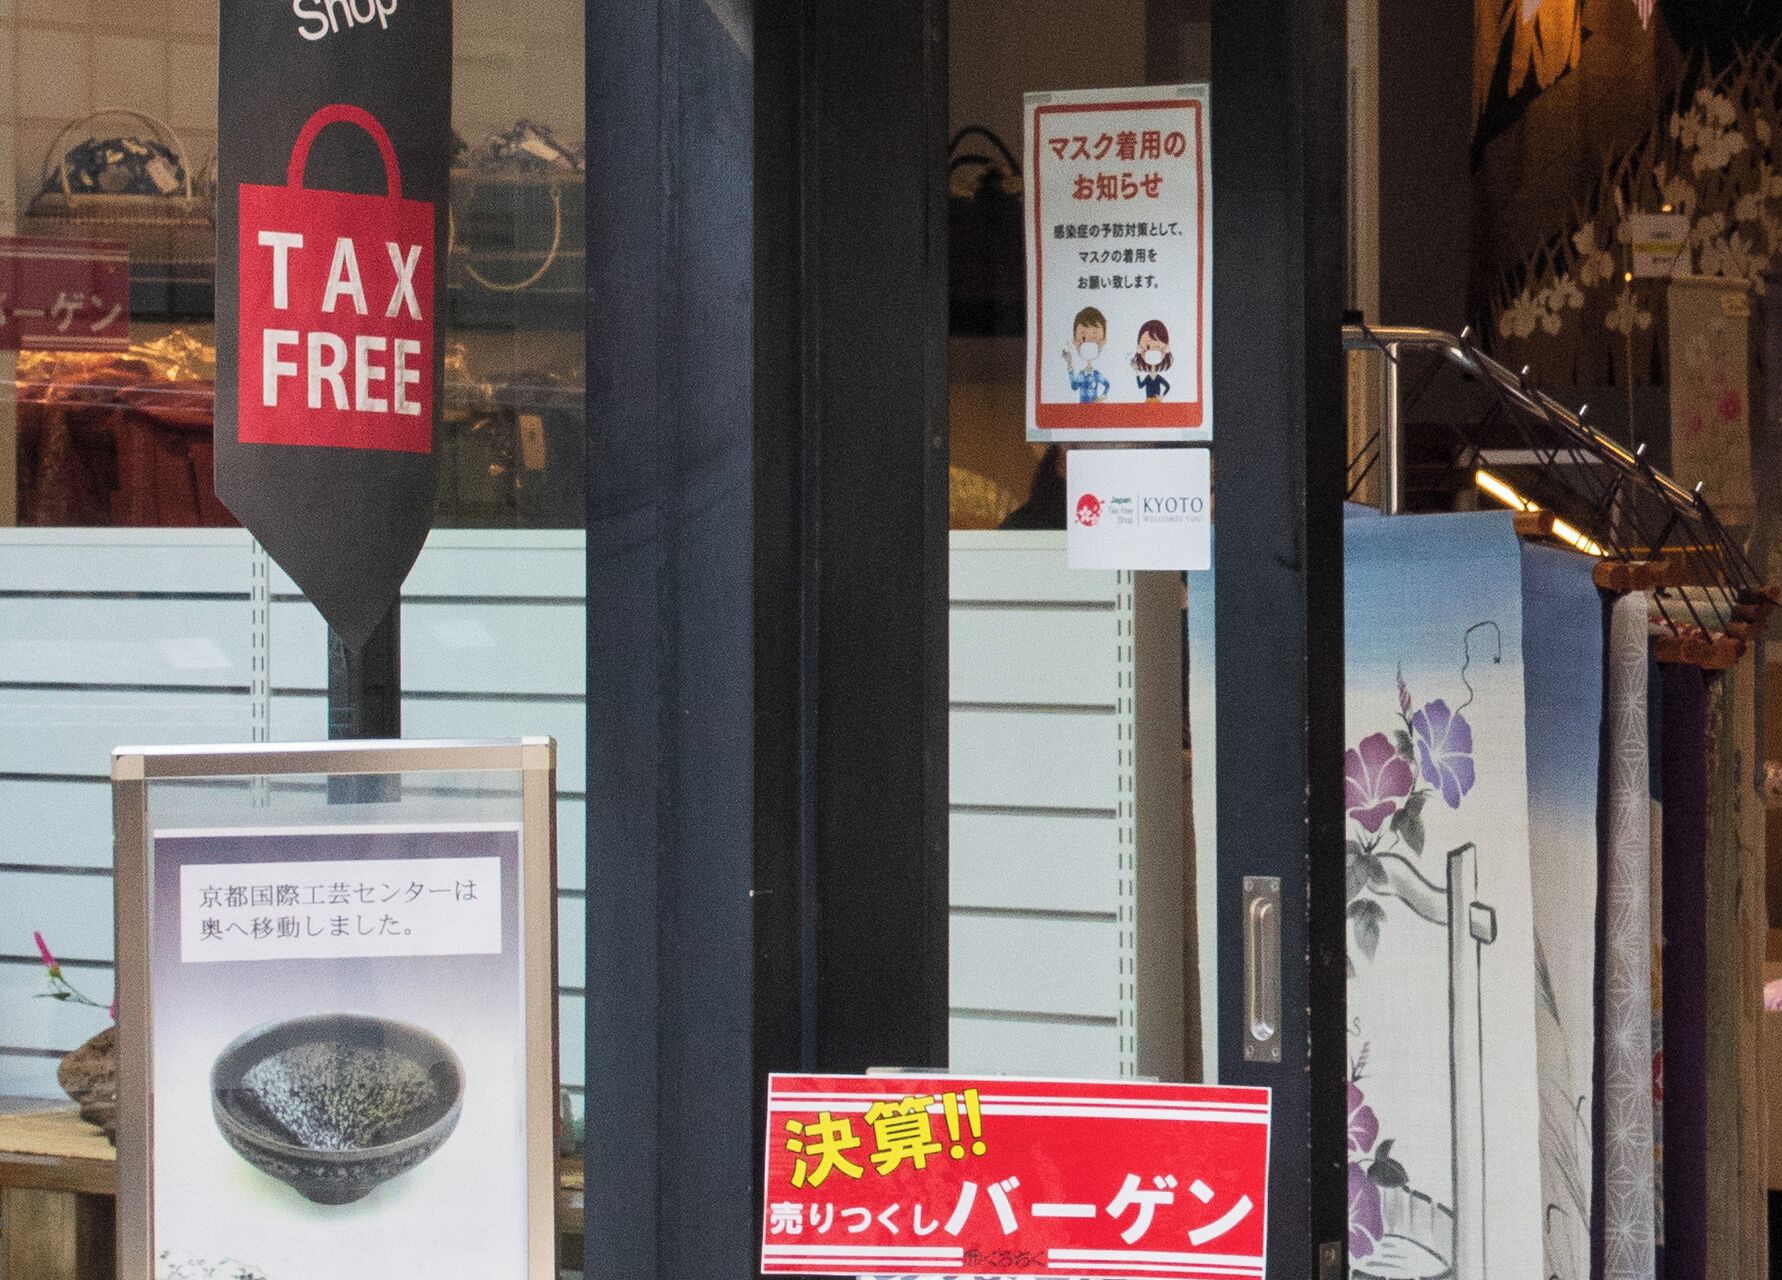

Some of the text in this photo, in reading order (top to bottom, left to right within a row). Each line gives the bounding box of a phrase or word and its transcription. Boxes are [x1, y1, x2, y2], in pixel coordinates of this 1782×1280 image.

[1049, 130, 1186, 161] マスク着用の
[1072, 173, 1164, 201] お知らせ
[1053, 222, 1183, 239] 感染症の予防対策として、
[1079, 249, 1157, 264] マスクの着用を
[258, 231, 424, 321] TAX
[1077, 274, 1160, 291] お願い致します。
[0, 291, 123, 333] ーゲン
[261, 329, 421, 416] FREE
[1143, 497, 1203, 513] KYOTO
[197, 879, 478, 909] 京都国際工芸センターは
[199, 913, 413, 941] 奥へ移動しました。
